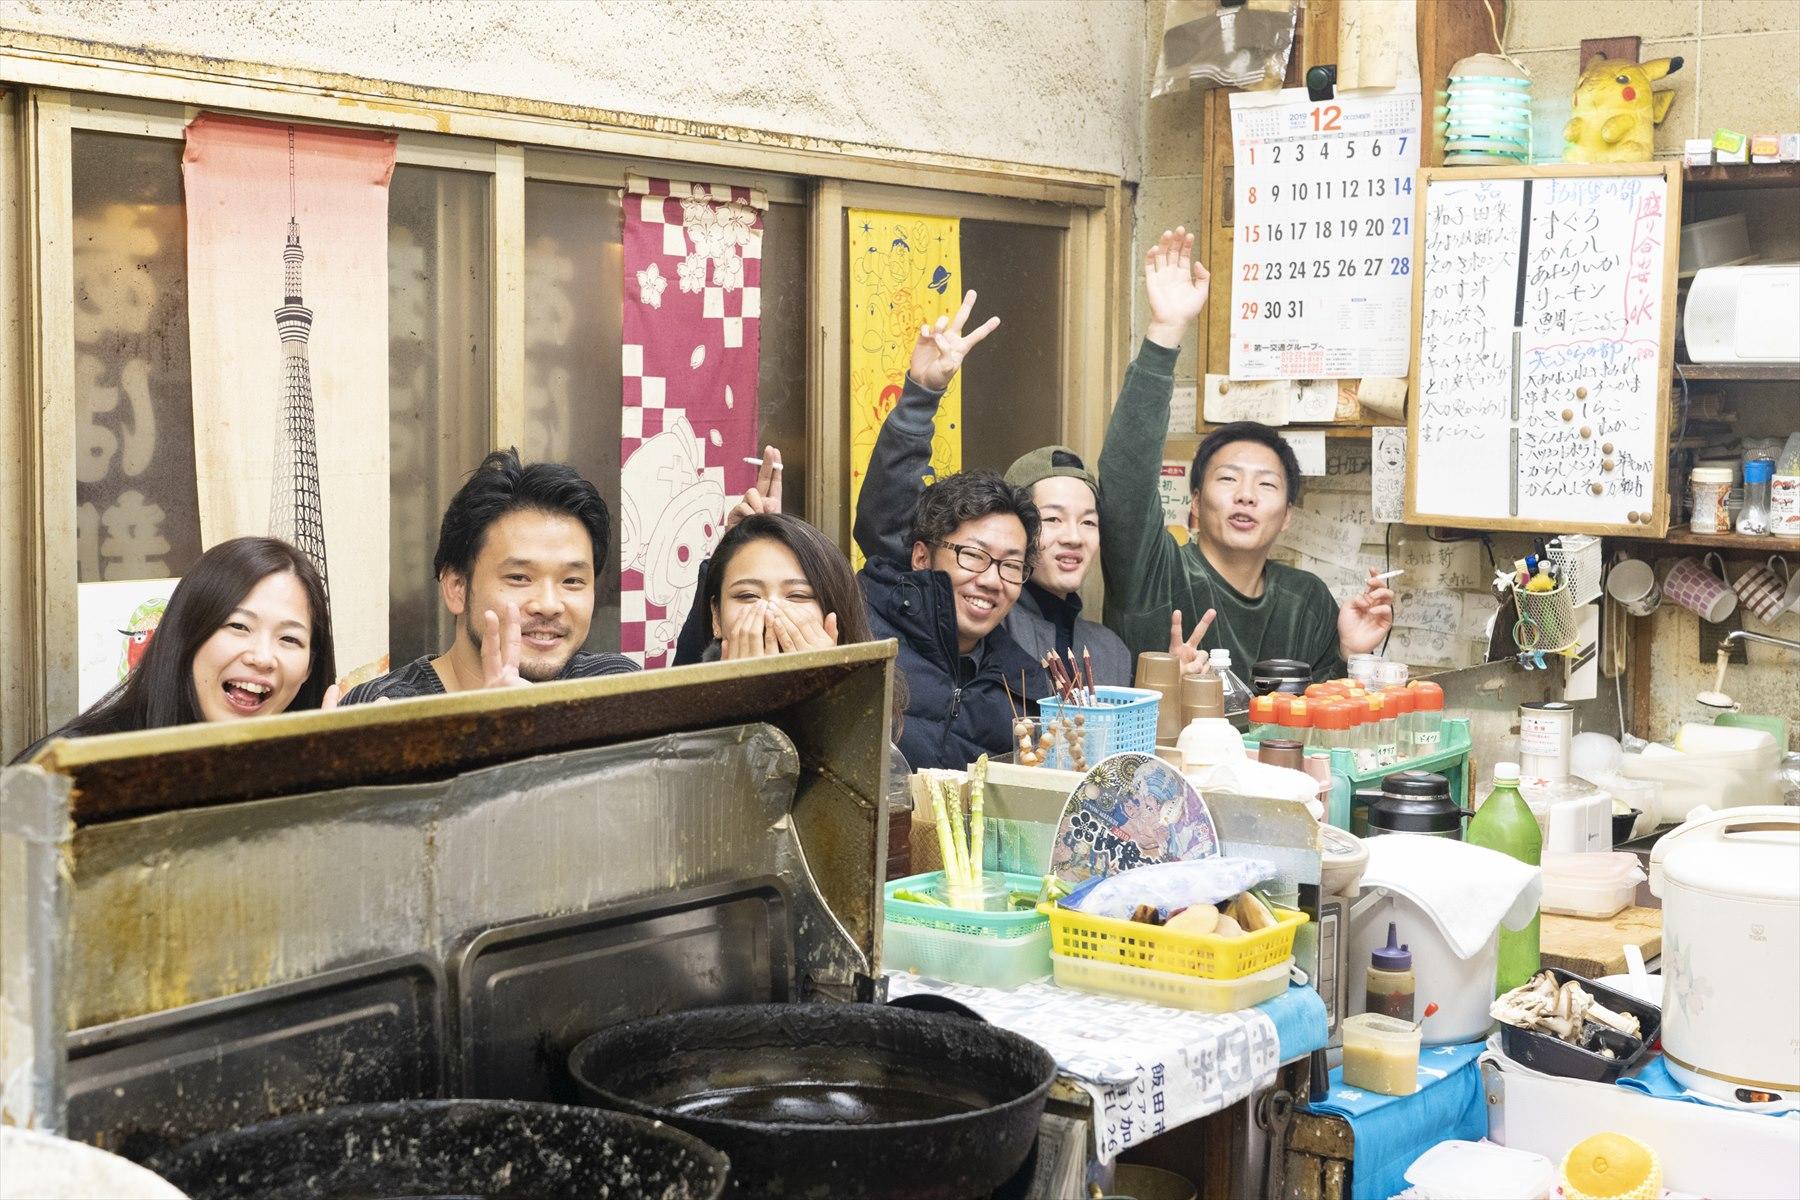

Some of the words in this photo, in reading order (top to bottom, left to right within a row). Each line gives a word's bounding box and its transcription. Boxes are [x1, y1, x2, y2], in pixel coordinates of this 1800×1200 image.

[1289, 113, 1308, 121] 2019
[1310, 105, 1342, 132] 12
[1250, 148, 1254, 164] 1
[1273, 146, 1280, 163] 2
[1296, 144, 1304, 161] 3
[1320, 143, 1329, 159] 4
[1347, 141, 1354, 158] 5
[1372, 139, 1381, 156] 6
[1399, 137, 1407, 155] 7
[1249, 187, 1256, 204] 8
[1272, 185, 1279, 202] 9
[1292, 183, 1307, 200] 10
[1317, 182, 1330, 199] 11
[1342, 180, 1358, 197] 12
[1368, 179, 1385, 196] 13
[1395, 177, 1412, 195] 14
[1245, 225, 1259, 242] 15
[1268, 224, 1282, 241] 16
[1291, 222, 1306, 240] 17
[1316, 221, 1331, 238] 18
[1341, 220, 1357, 237] 19
[1366, 219, 1384, 236] 20
[1392, 217, 1408, 235] 21
[1243, 264, 1259, 281] 22
[1266, 263, 1282, 280] 23
[1289, 262, 1306, 279] 24
[1313, 260, 1330, 278] 25
[1338, 259, 1356, 277] 26
[1364, 258, 1383, 276] 27
[1391, 257, 1410, 276] 28
[1242, 303, 1258, 319] 29
[1264, 302, 1281, 319] 30
[1288, 301, 1303, 318] 31
[1254, 342, 1325, 352] 第一交通グループへ
